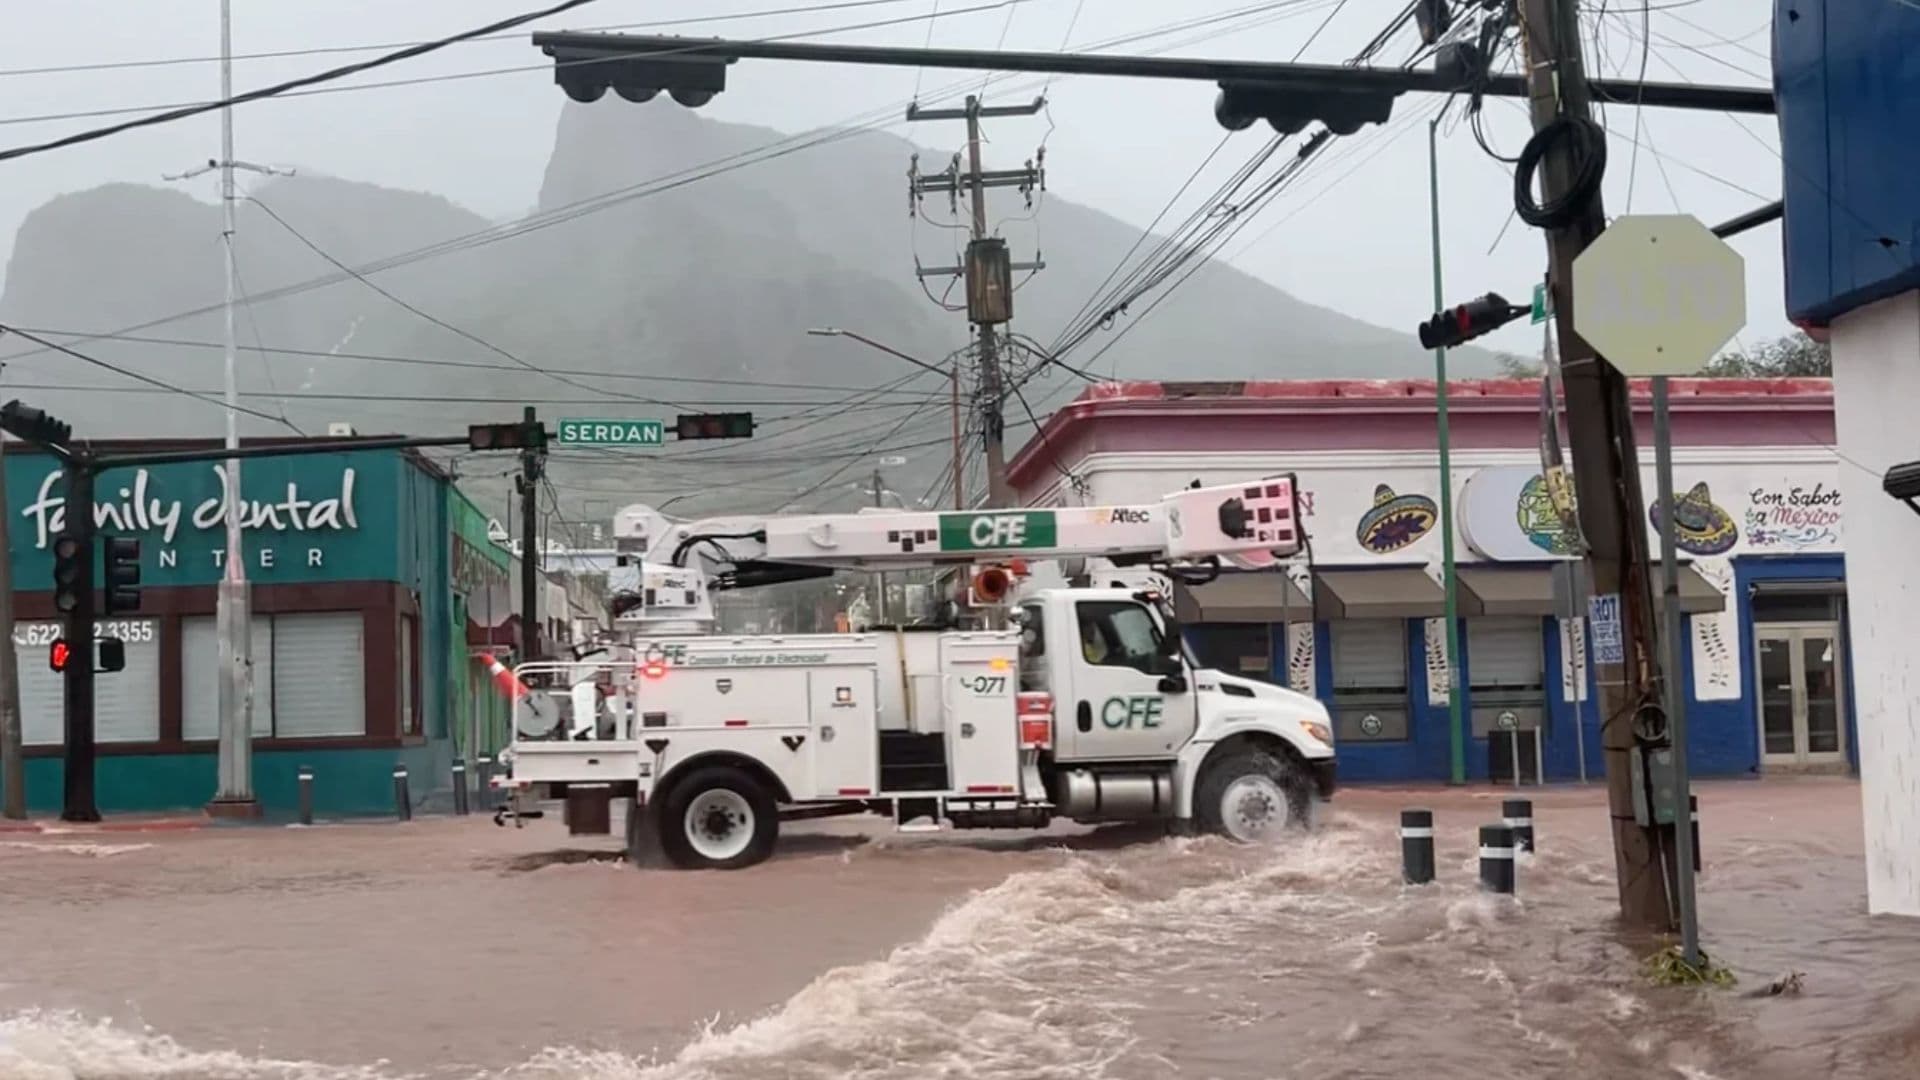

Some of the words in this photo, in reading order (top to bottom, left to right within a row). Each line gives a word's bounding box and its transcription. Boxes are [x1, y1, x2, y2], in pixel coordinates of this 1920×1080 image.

[564, 424, 658, 442] SERDAN
[1749, 488, 1785, 506] Con
[1788, 483, 1842, 506] Sabor
[1111, 508, 1150, 523] Altec
[970, 514, 1028, 547] CFE
[160, 549, 322, 568] NTER
[1102, 697, 1163, 729] CFE
